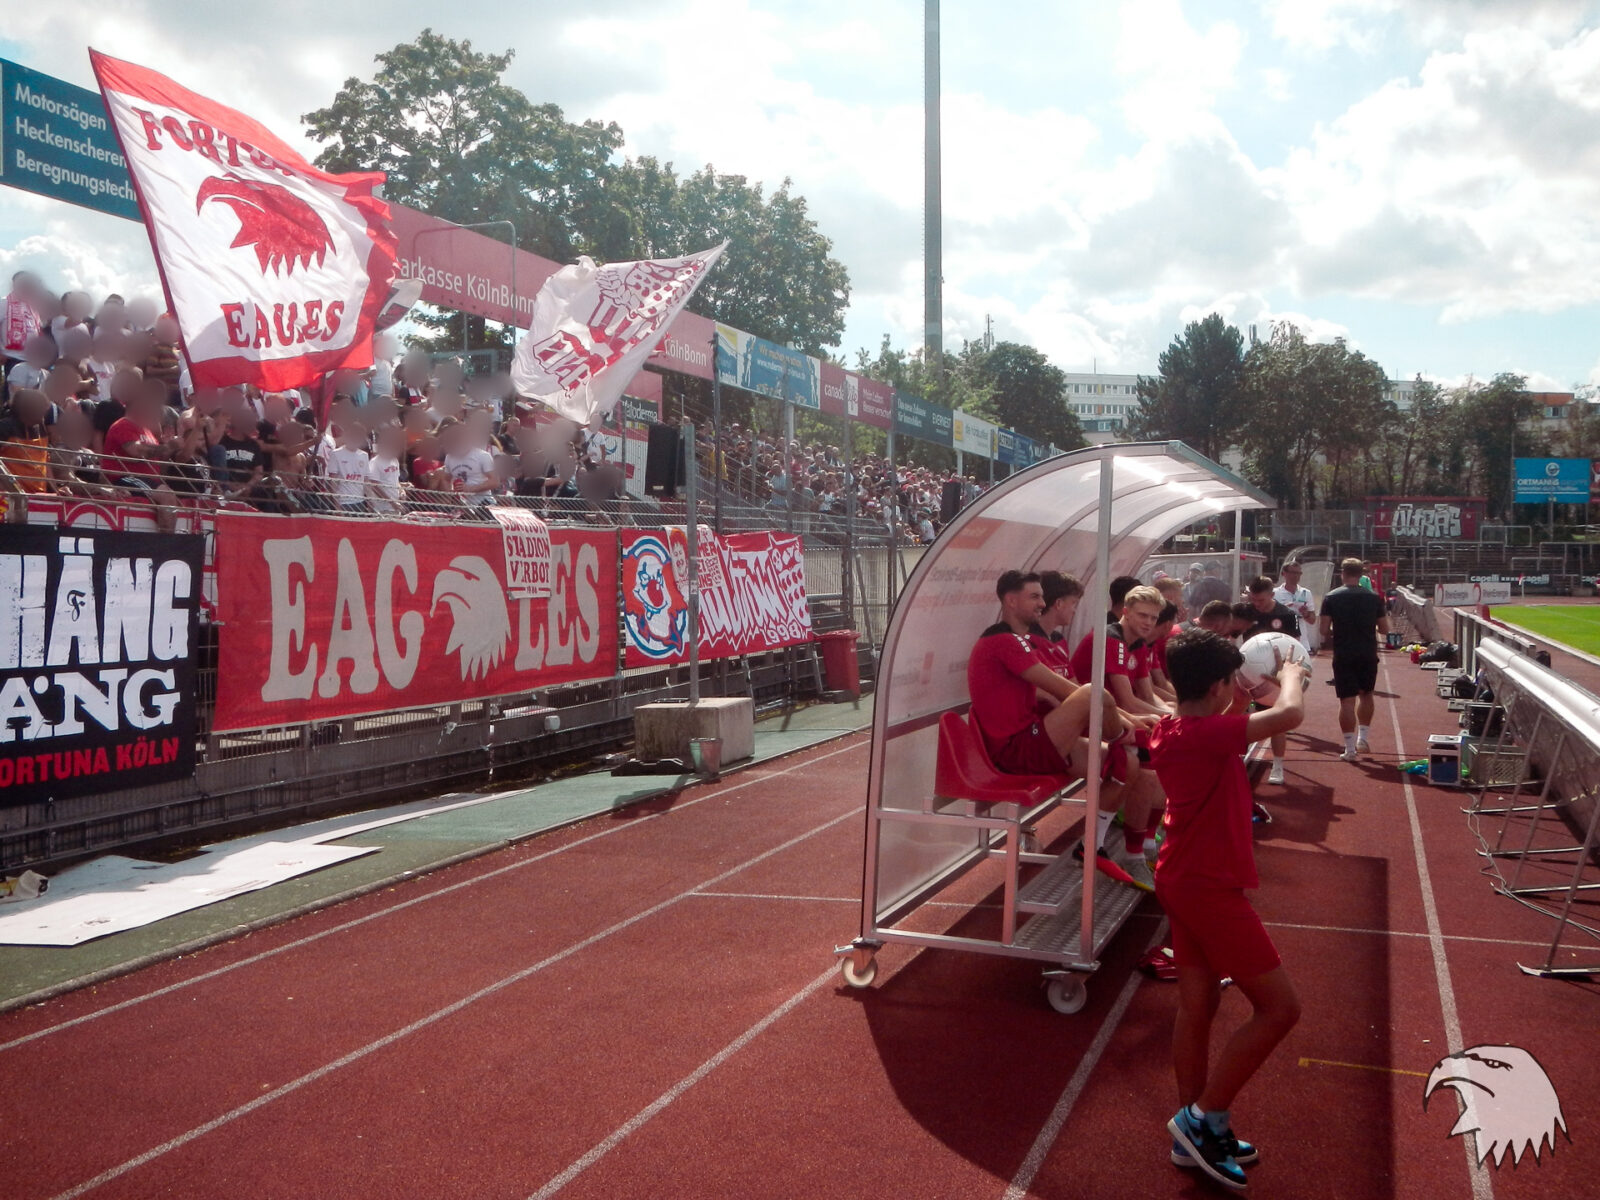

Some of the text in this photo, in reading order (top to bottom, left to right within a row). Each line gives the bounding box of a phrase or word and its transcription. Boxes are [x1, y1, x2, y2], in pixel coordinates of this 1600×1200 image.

[15, 82, 107, 131] Motorsägen
[16, 115, 127, 168] Heckenscheren
[16, 148, 137, 202] Beregnungstech
[400, 256, 463, 294] arkasse
[506, 535, 550, 558] STADION
[1470, 574, 1499, 583] capelli
[764, 619, 801, 646] 1998
[0, 736, 179, 788] ORTUNA KÖLN
